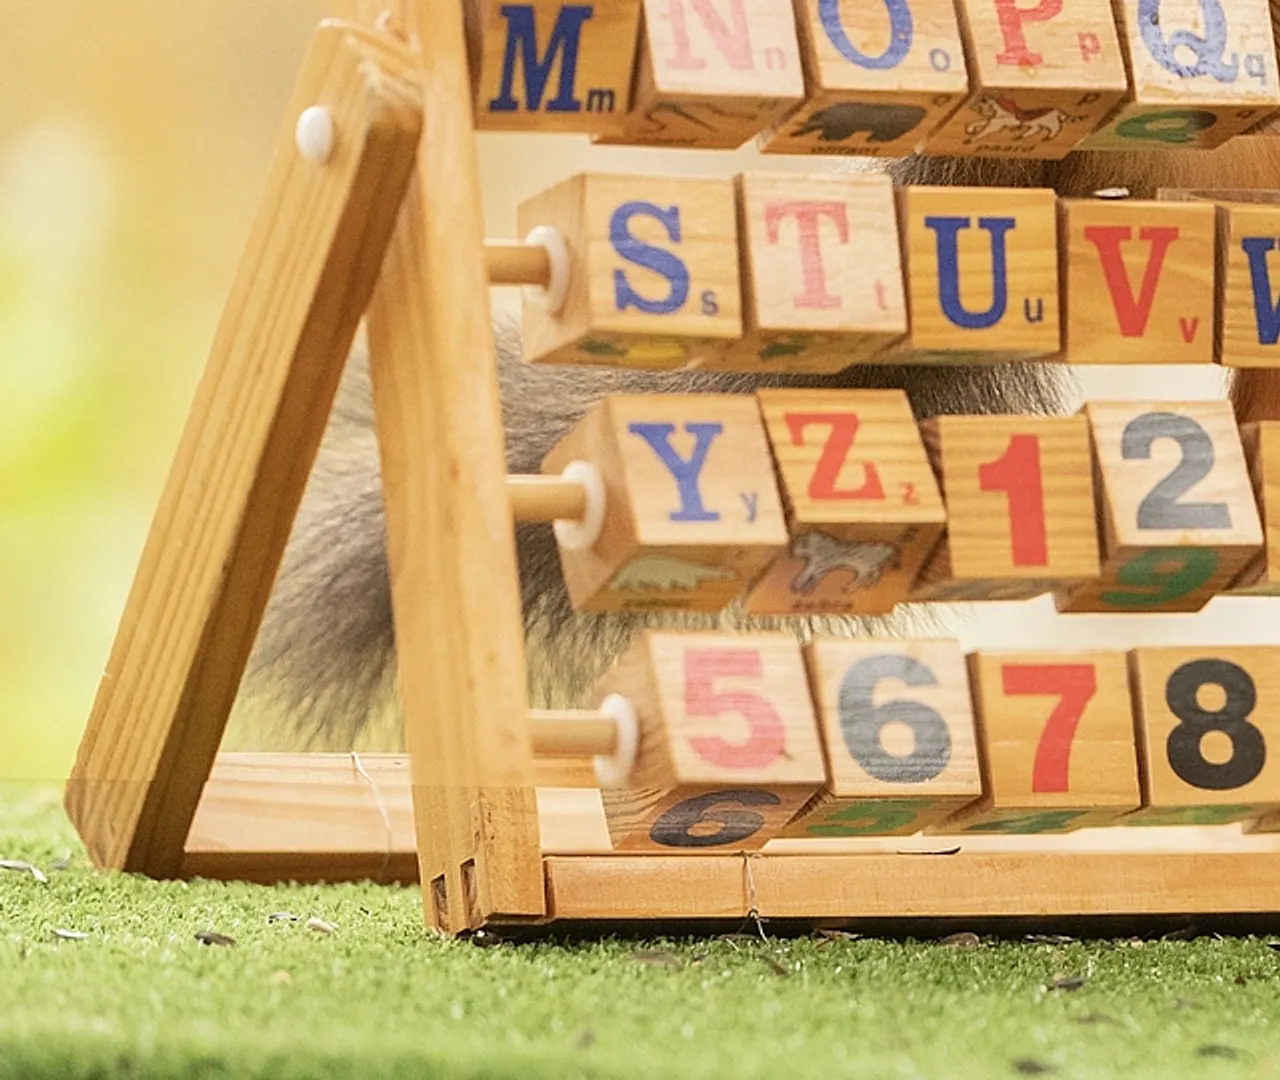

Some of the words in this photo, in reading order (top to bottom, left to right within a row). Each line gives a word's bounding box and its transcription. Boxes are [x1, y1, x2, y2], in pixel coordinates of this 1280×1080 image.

[487, 4, 593, 112] M
[586, 87, 615, 112] m
[762, 47, 786, 70] n
[1077, 30, 1100, 62] p
[1243, 53, 1266, 85] q
[609, 201, 690, 315] S
[701, 291, 717, 316] s
[765, 201, 849, 309] T
[874, 279, 890, 309] t
[924, 216, 1016, 329] U
[1023, 296, 1043, 323] u
[1084, 226, 1179, 337] V
[628, 422, 723, 521] Y
[784, 412, 885, 500] Z
[978, 433, 1048, 567] 1
[1122, 412, 1233, 530] 2
[1101, 547, 1218, 606] 9
[683, 648, 786, 770] 5
[837, 653, 953, 784] 6
[1002, 663, 1097, 793] 7
[1165, 658, 1266, 791] 8
[648, 789, 781, 848] 6
